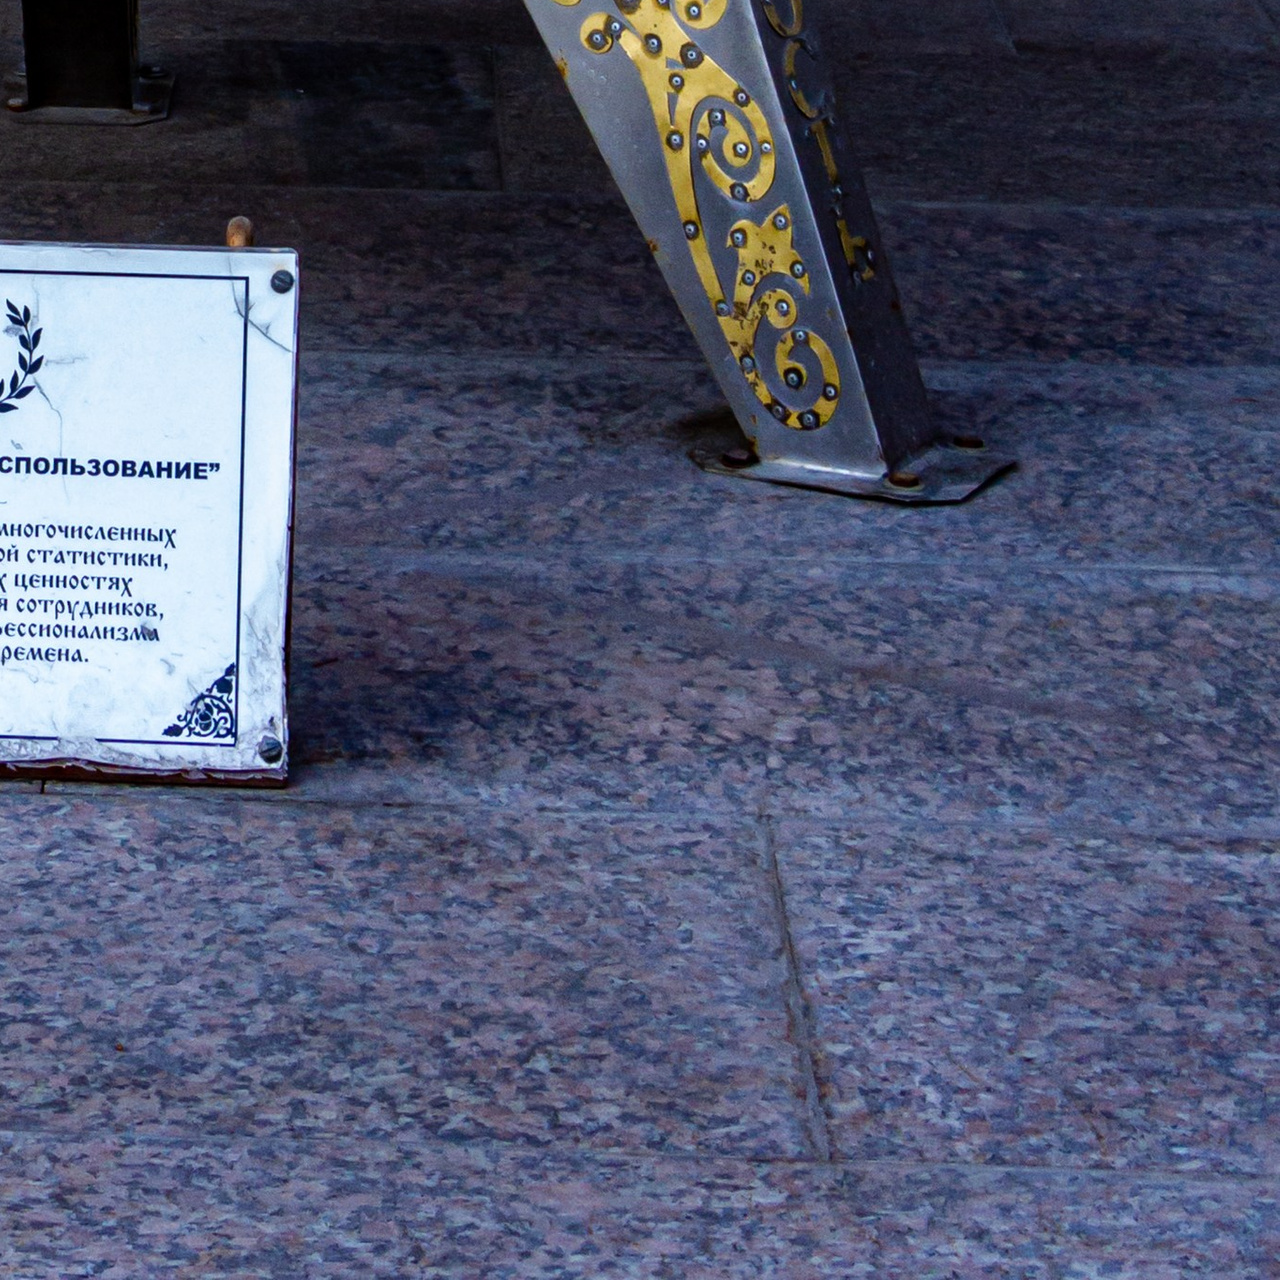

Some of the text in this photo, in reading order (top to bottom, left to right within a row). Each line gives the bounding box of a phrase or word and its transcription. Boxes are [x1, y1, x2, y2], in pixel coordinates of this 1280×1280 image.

[26, 548, 169, 571] статистики,
[14, 573, 133, 597] ценностях
[16, 597, 164, 621] сотрудников,
